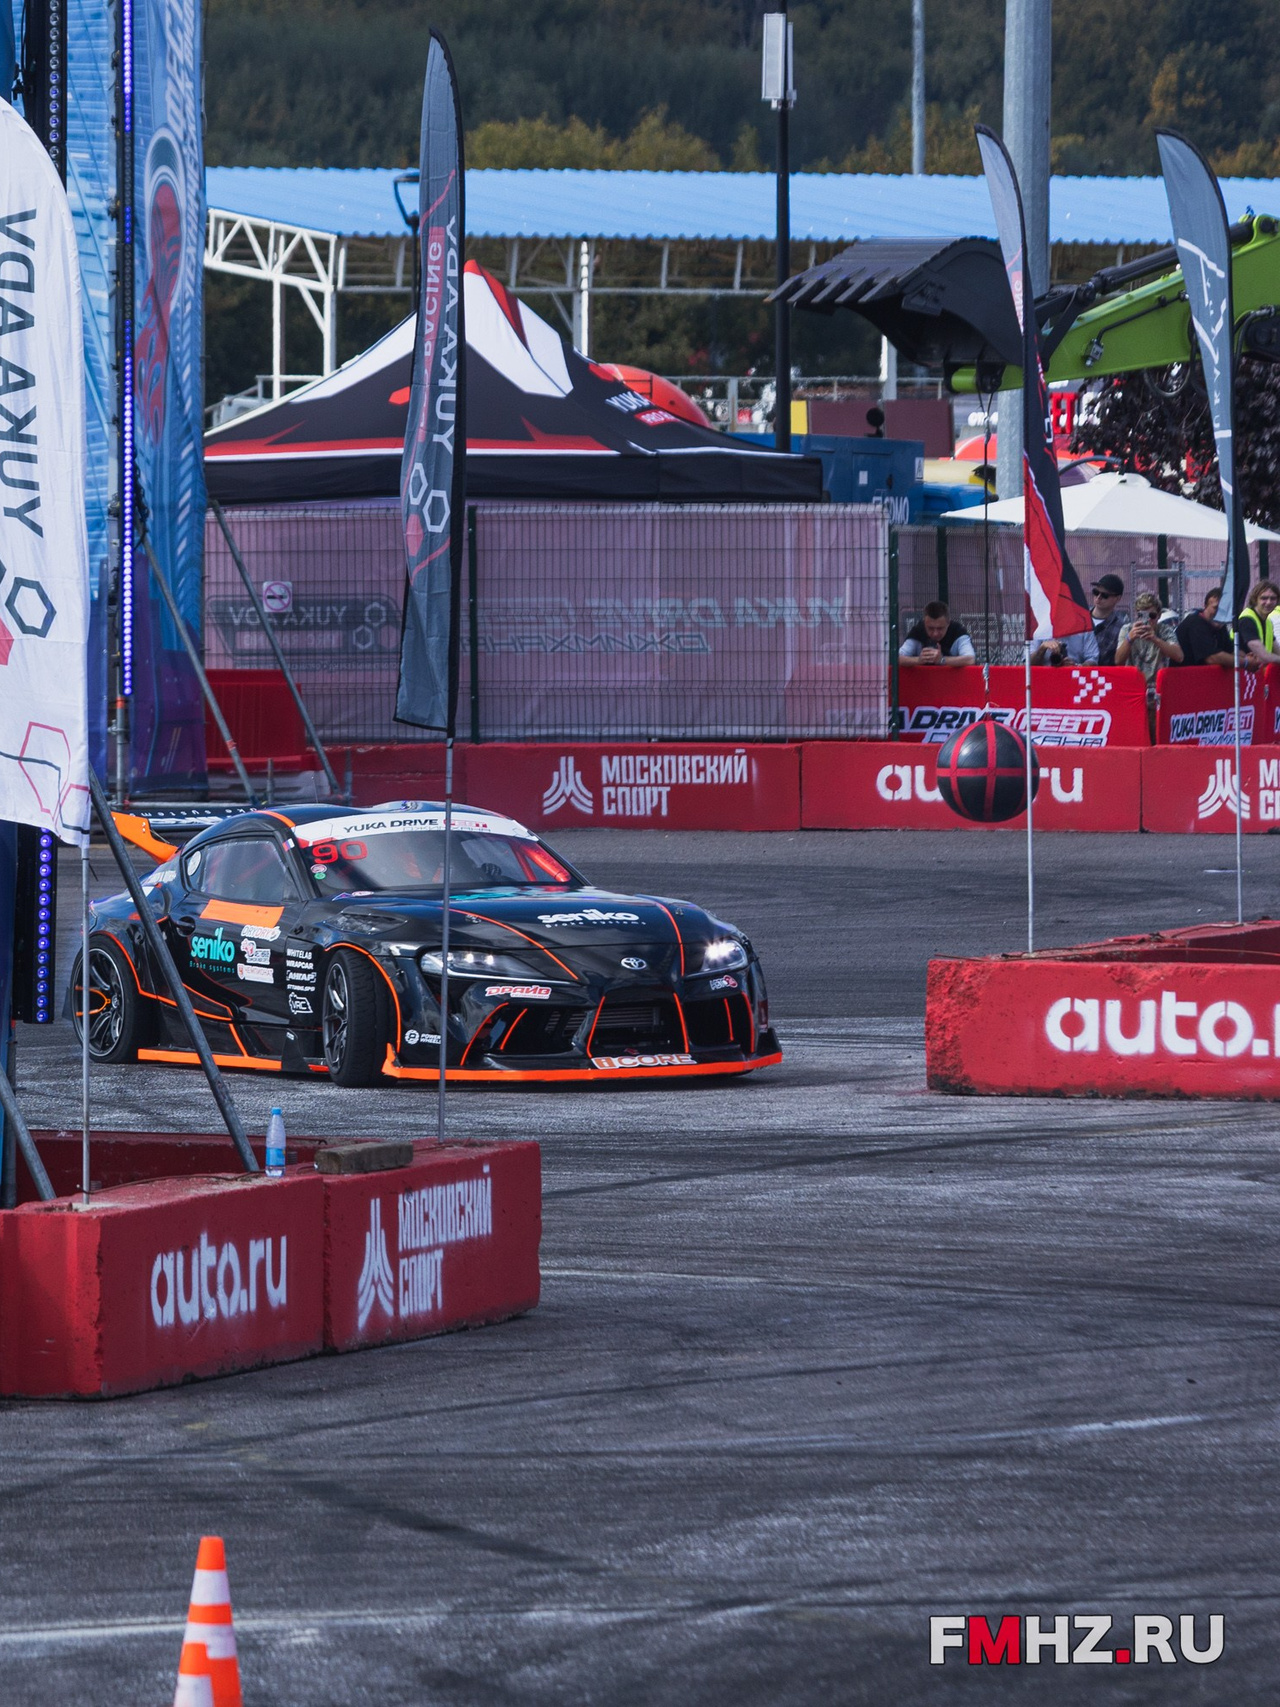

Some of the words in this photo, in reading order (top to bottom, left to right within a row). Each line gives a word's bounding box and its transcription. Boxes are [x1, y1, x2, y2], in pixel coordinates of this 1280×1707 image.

[601, 749, 748, 785] МОСКОВСКИЙ
[602, 786, 671, 817] СПОРТ
[343, 821, 387, 833] YUKA
[390, 818, 439, 828] DRIVE
[312, 840, 369, 864] 90
[537, 908, 640, 923] seniko
[190, 926, 236, 963] seniko
[397, 1164, 493, 1253] МОСКОВСКИЙ
[150, 1232, 287, 1328] auto.ru
[397, 1249, 444, 1319] СПОРТ
